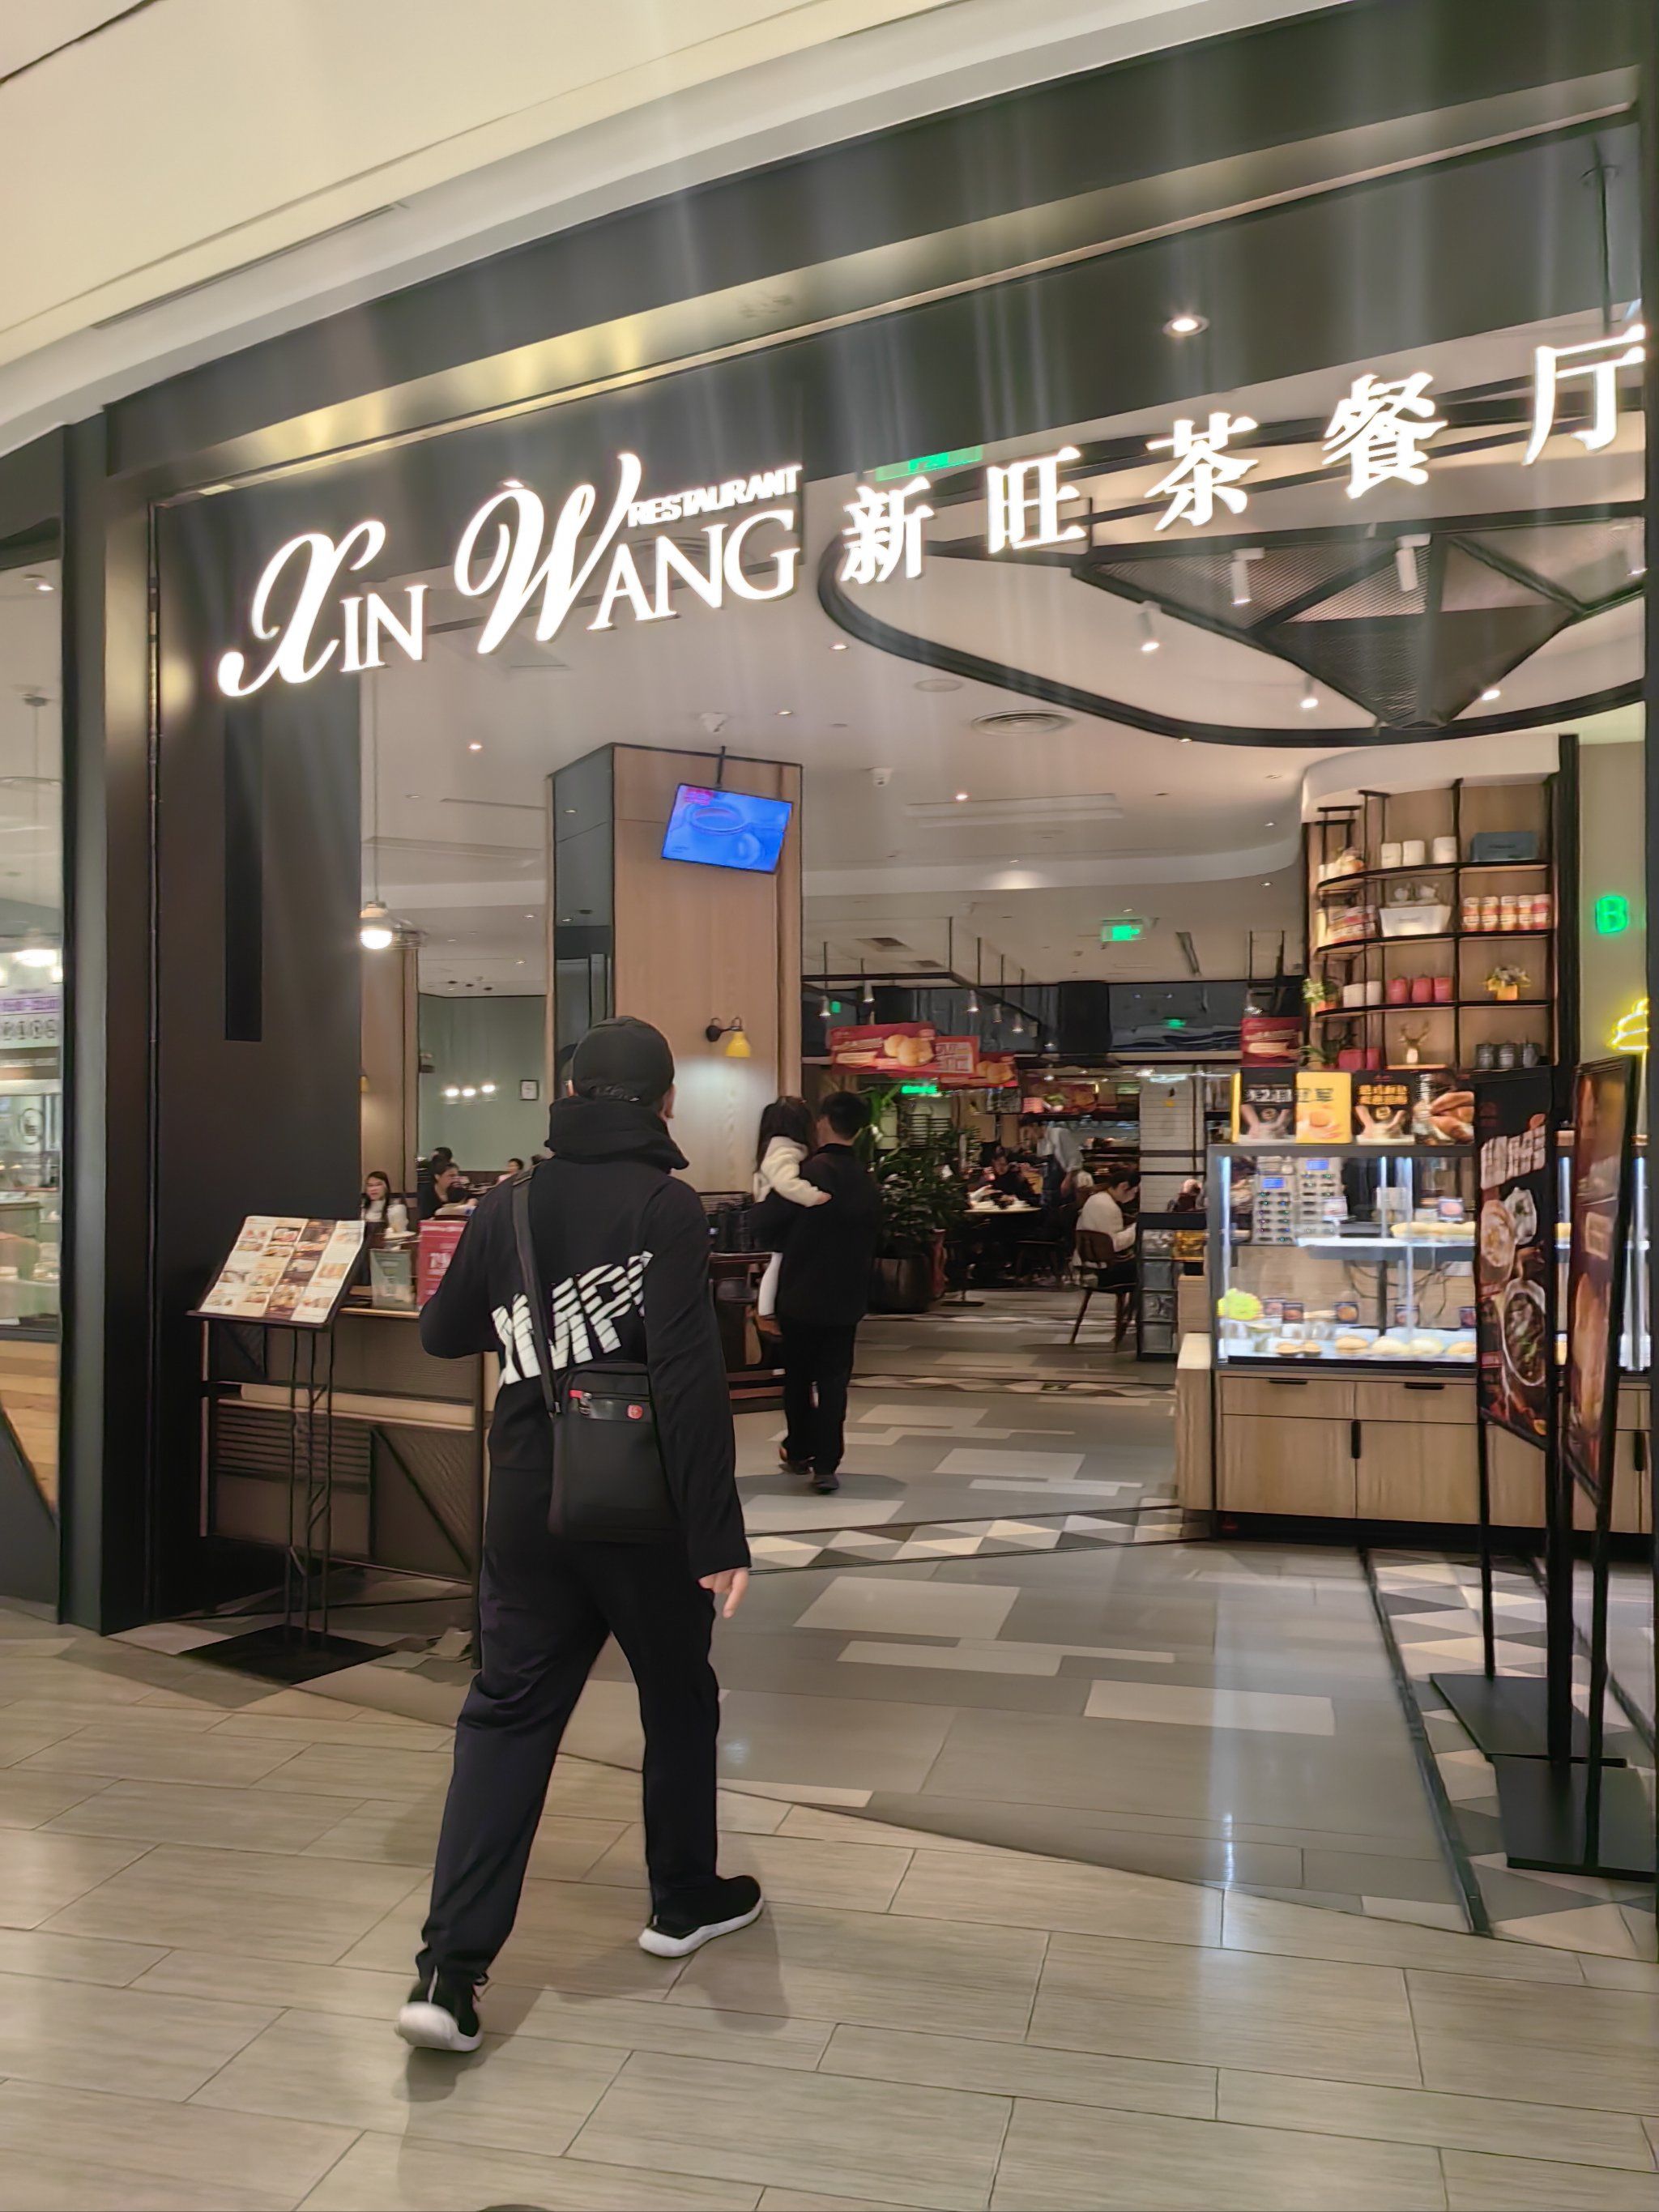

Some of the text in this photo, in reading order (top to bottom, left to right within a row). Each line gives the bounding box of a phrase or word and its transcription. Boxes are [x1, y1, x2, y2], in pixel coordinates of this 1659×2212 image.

[453, 452, 801, 655] WANG
[628, 464, 803, 527] RESTAURANT
[839, 324, 1648, 585] 新旺茶餐厅
